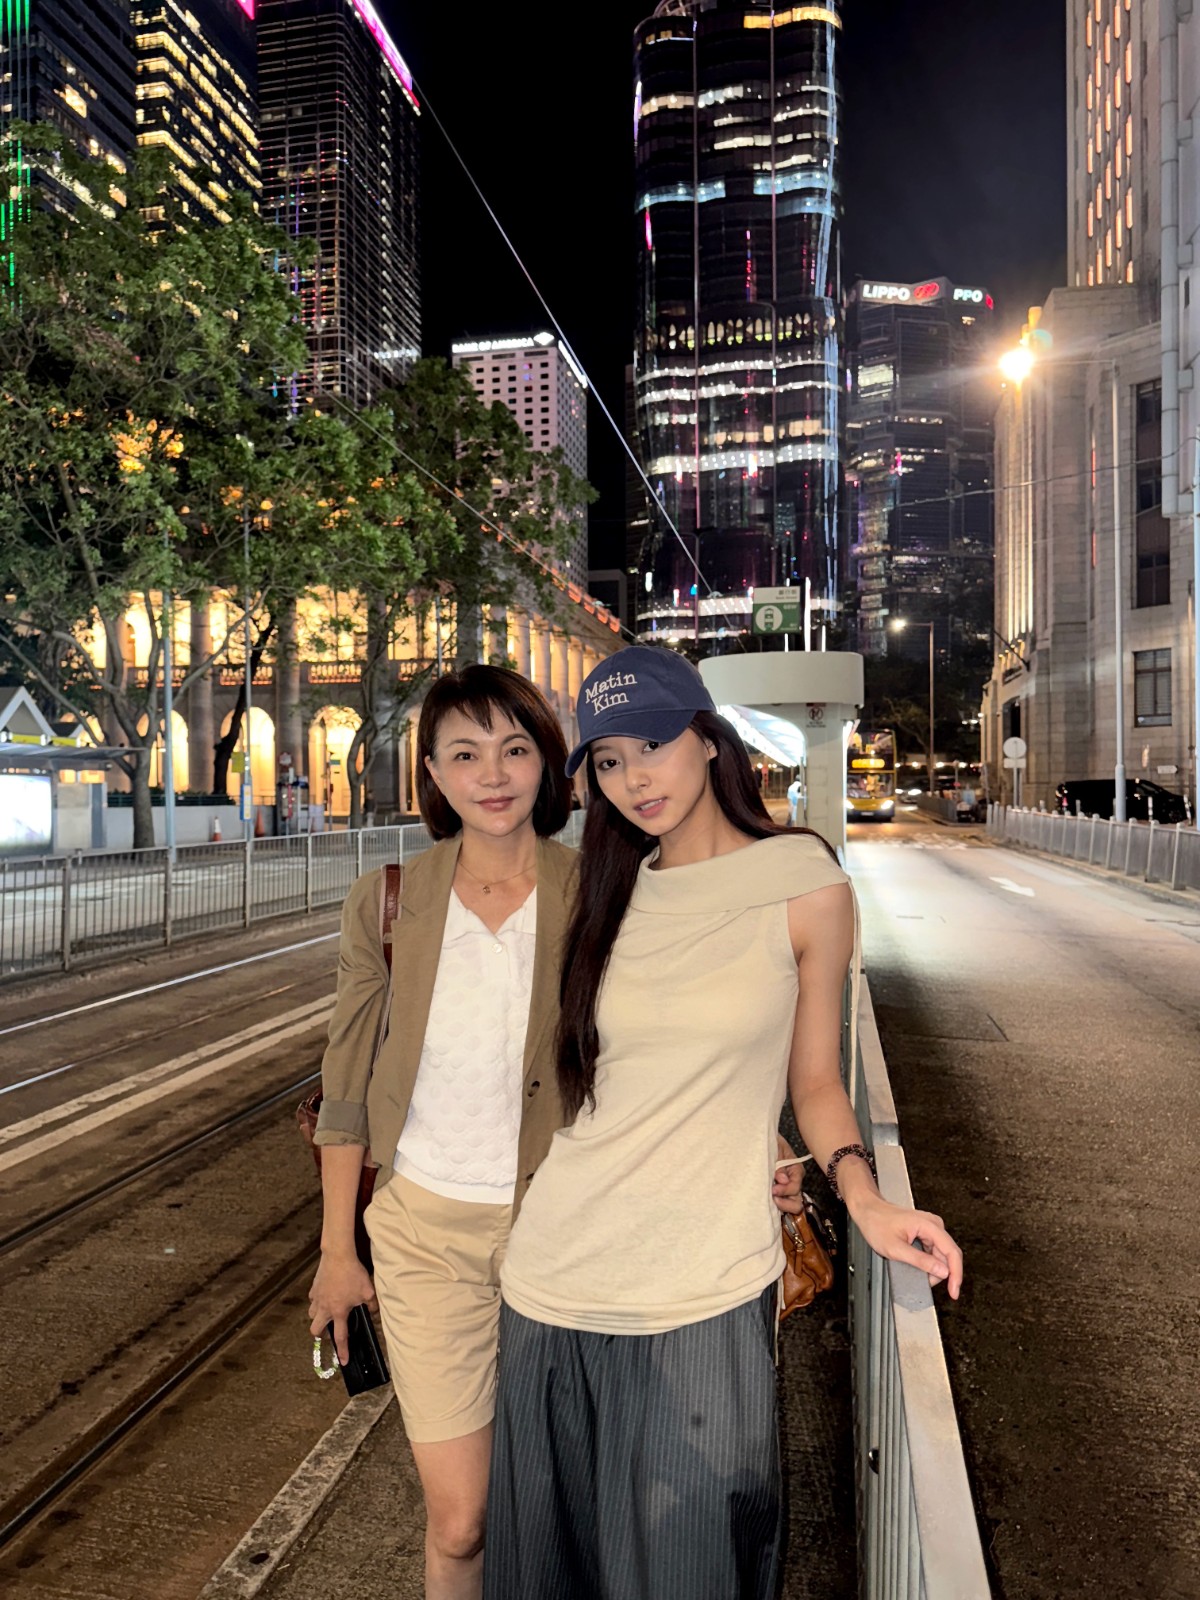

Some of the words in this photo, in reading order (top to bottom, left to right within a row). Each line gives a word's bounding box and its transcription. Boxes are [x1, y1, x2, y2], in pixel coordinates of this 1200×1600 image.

[862, 284, 911, 301] LIPPO
[585, 671, 638, 704] Matin
[592, 691, 630, 716] Kim
